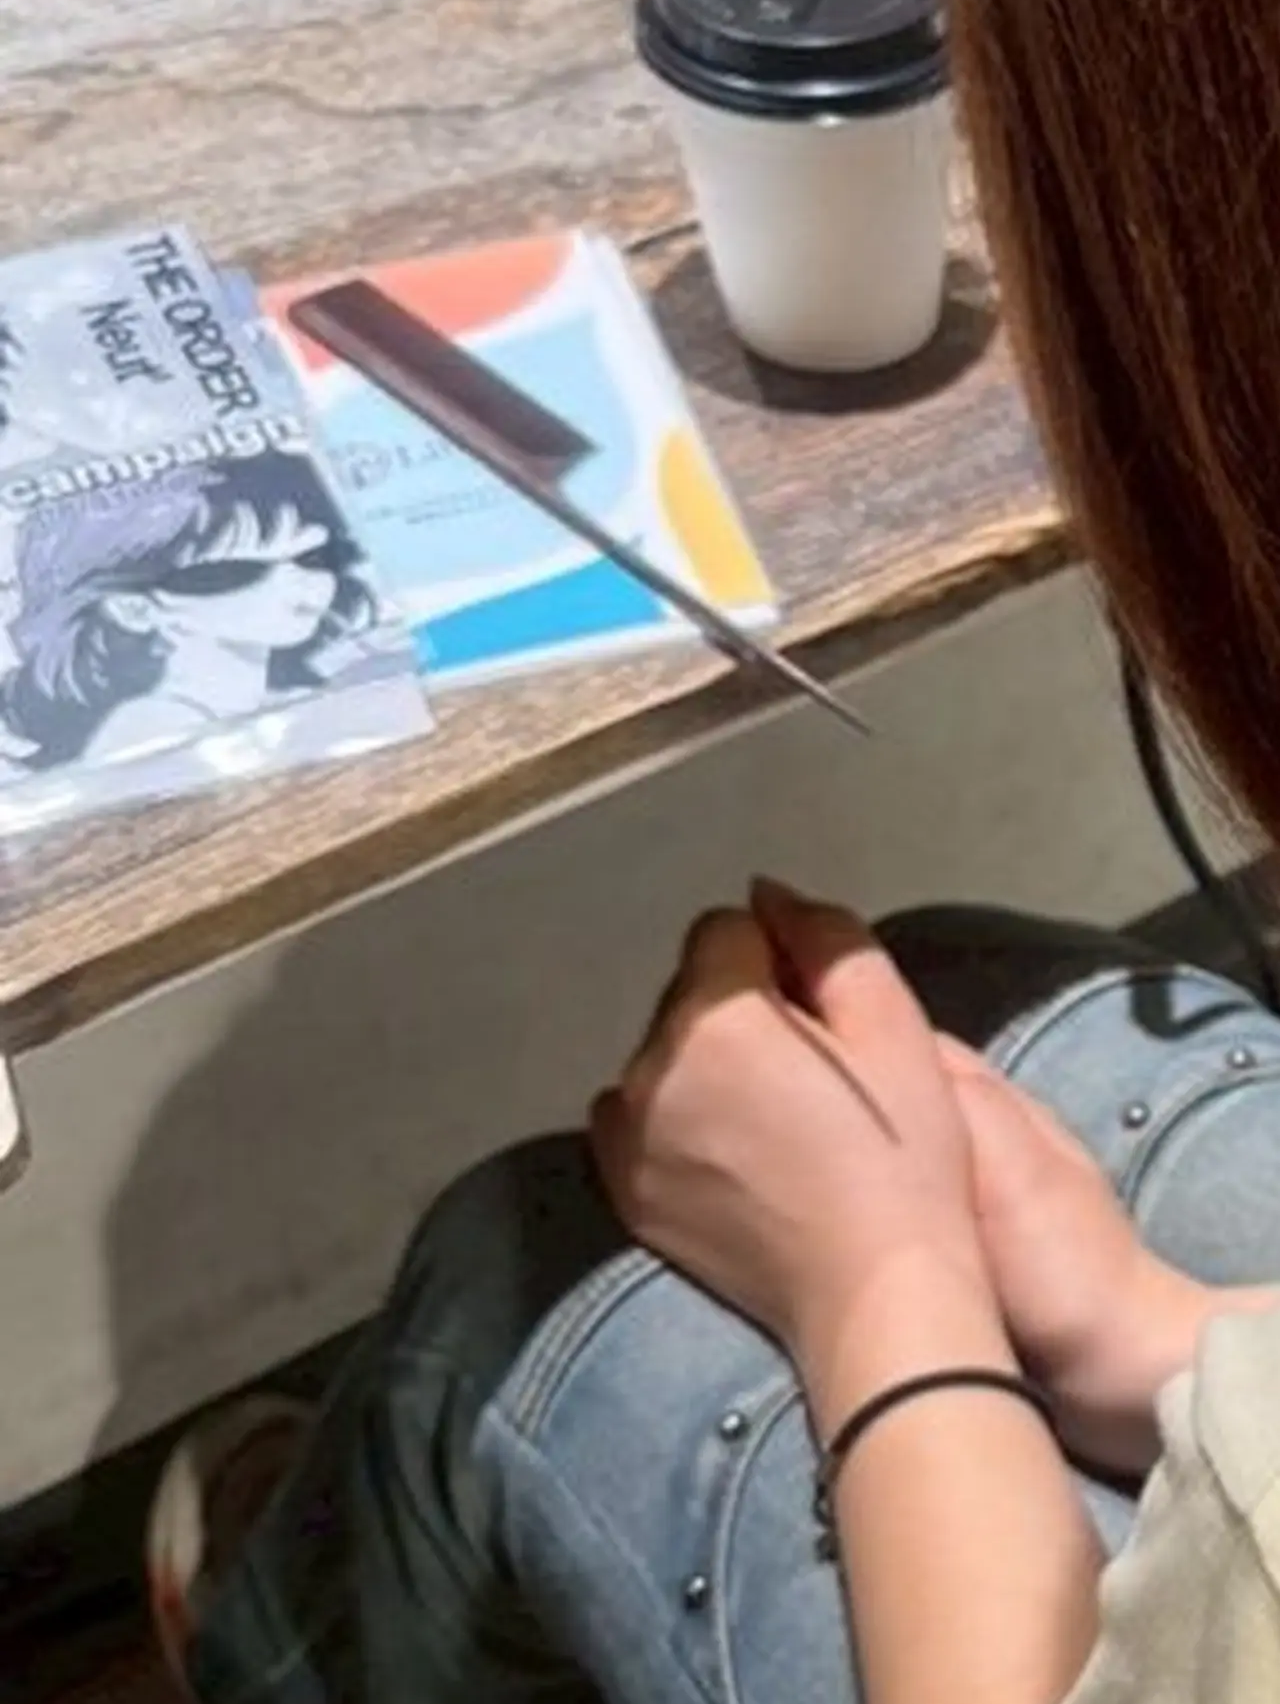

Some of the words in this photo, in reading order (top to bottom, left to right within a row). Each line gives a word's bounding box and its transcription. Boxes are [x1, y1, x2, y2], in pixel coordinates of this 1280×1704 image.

[125, 235, 199, 303] THE
[162, 297, 260, 418] ORDER
[3, 414, 304, 507] campaign
